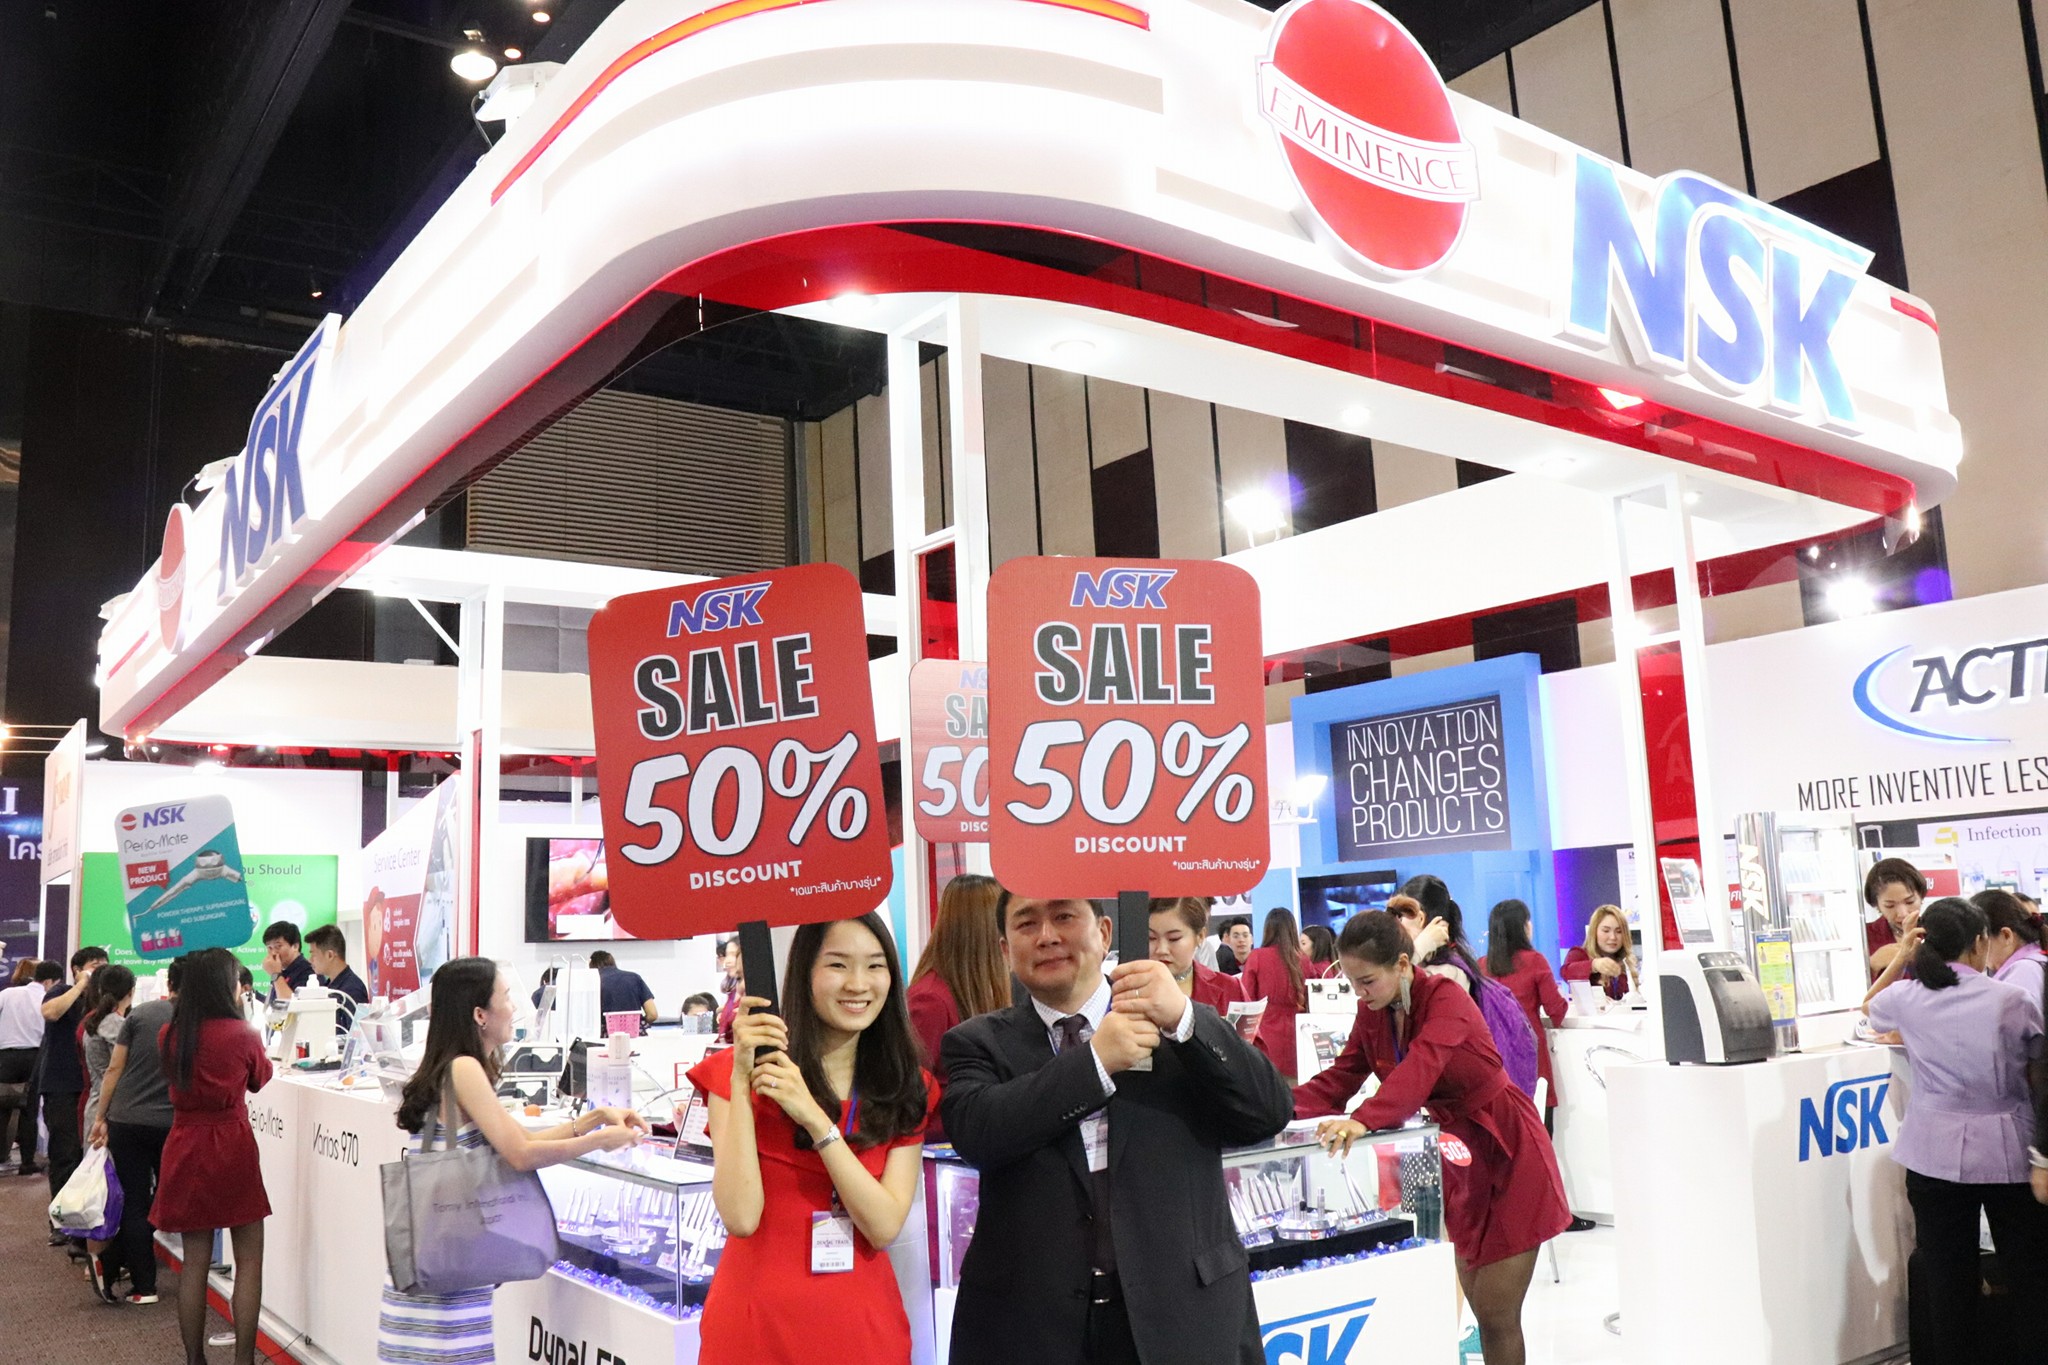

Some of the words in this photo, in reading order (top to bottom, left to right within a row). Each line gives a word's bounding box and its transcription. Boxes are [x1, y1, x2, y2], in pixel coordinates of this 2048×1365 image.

[1270, 86, 1466, 190] EMINENCE
[1567, 152, 1876, 424] NSK
[217, 327, 327, 598] NSK
[667, 581, 772, 637] NSK
[1070, 567, 1177, 609] NSK
[633, 632, 819, 741] SALE
[959, 668, 988, 690] NS
[1034, 621, 1215, 706] SALE
[1910, 638, 2048, 712] ACT
[944, 694, 988, 739] SA
[1346, 705, 1498, 761] INNOVATION
[620, 730, 869, 866] 50%
[918, 746, 990, 818] 50
[1005, 718, 1255, 826] 50%
[1349, 744, 1501, 806] CHANGES
[1797, 776, 1861, 812] MORE
[1868, 762, 1995, 807] INVENTIVE
[142, 802, 187, 828] NSK
[960, 821, 988, 833] DISC
[1351, 790, 1504, 844] PRODUCTS
[1967, 824, 2043, 842] Infection
[123, 833, 190, 854] Perio-Mate
[137, 864, 157, 875] NEW
[259, 864, 302, 875] Should
[373, 851, 397, 874] Service
[398, 846, 421, 871] Center
[1075, 836, 1187, 854] DISCOUNT
[130, 872, 168, 885] PRODUCT
[689, 860, 802, 890] DISCOUNT
[1799, 1073, 1892, 1162] NSK
[313, 1122, 340, 1160] Varios
[341, 1130, 359, 1167] 970
[1259, 1297, 1377, 1365] SK
